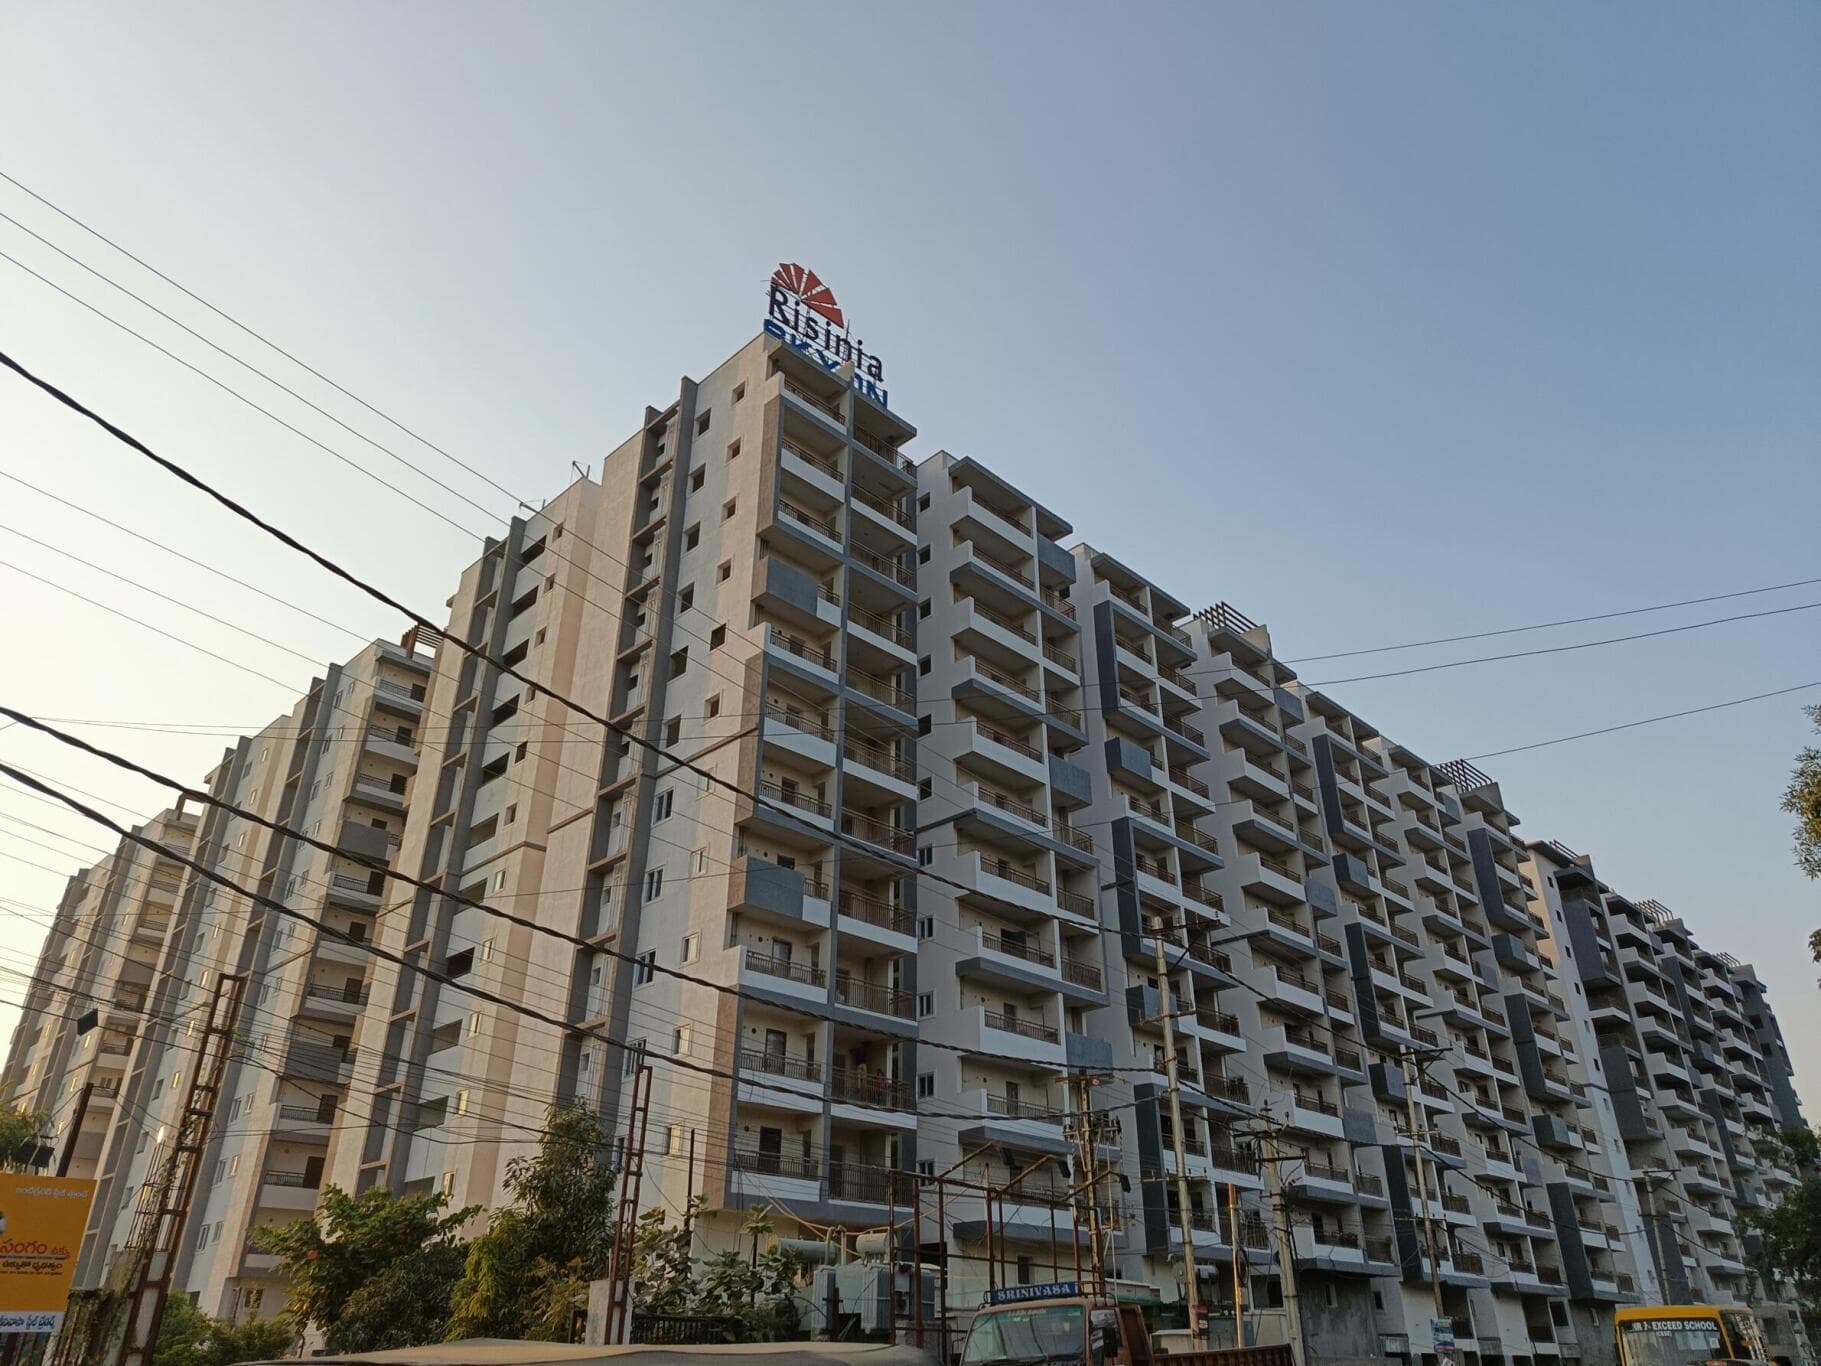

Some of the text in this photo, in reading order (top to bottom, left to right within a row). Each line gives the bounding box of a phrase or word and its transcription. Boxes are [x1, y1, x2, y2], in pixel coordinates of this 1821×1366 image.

[769, 285, 884, 382] Risinia
[997, 1283, 1071, 1301] SRINIVASA
[1652, 1320, 1683, 1331] EXCEED
[1684, 1320, 1718, 1331] SCHOOL
